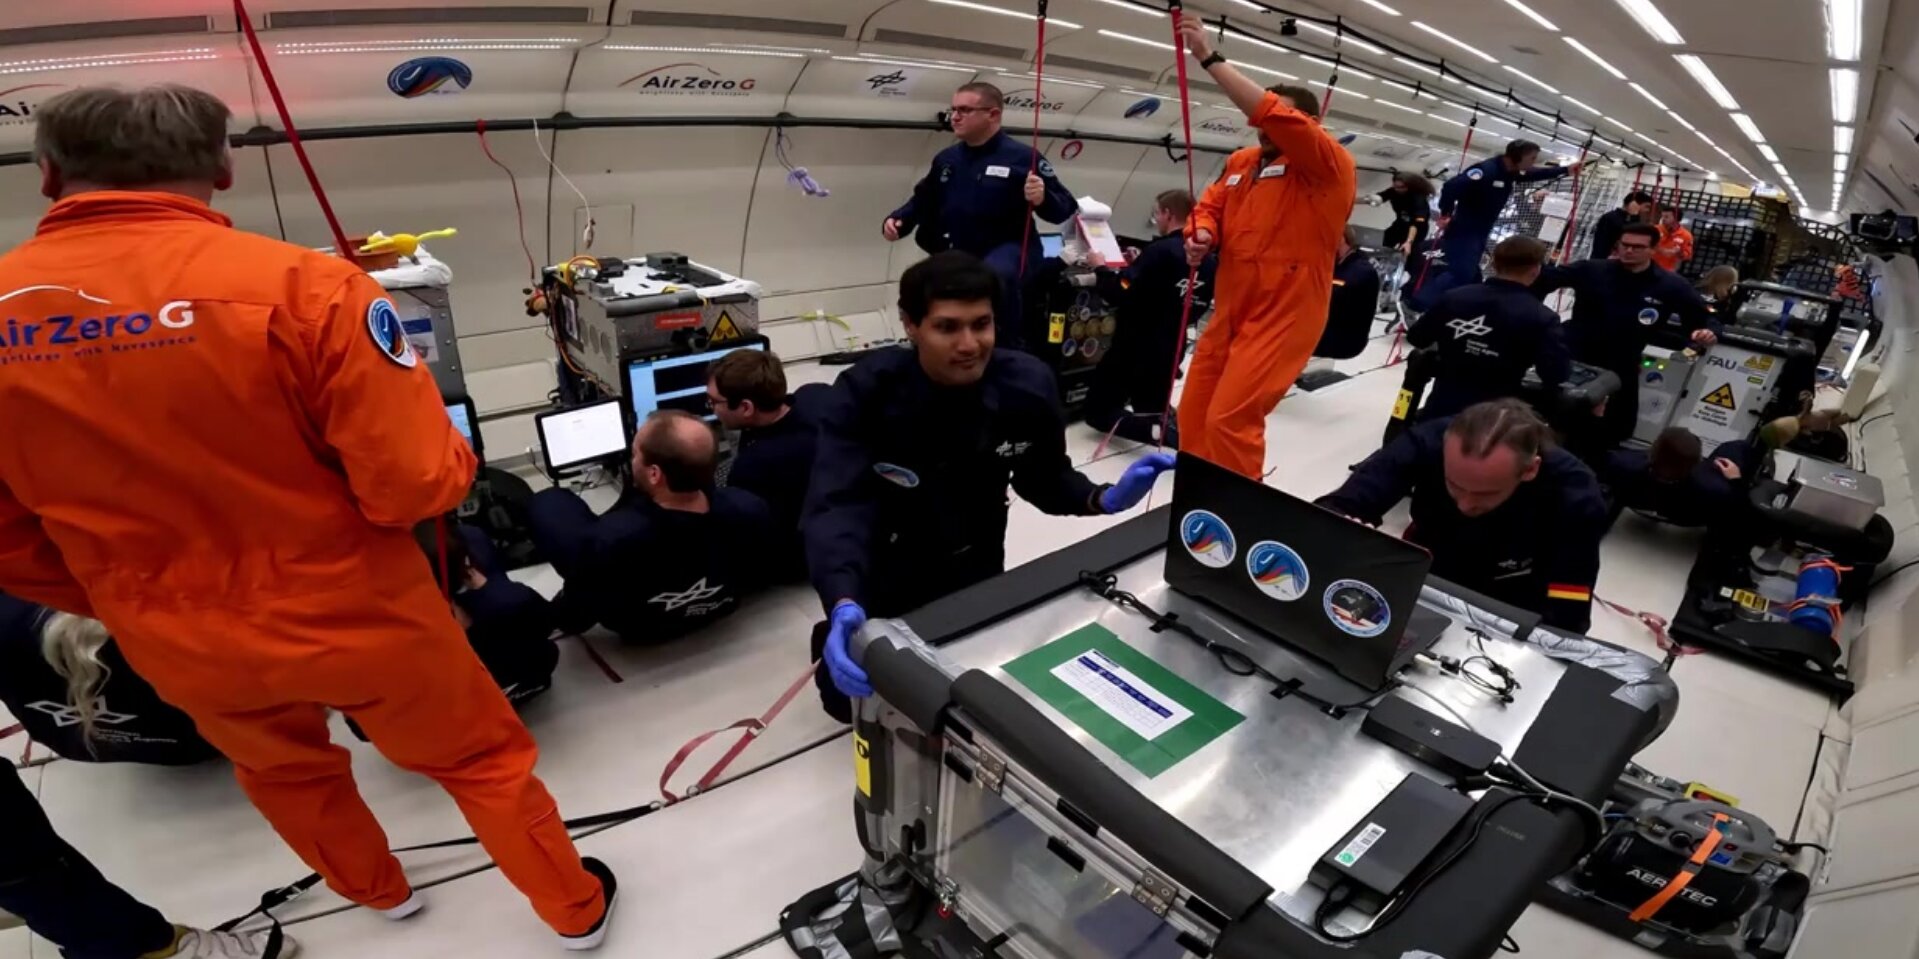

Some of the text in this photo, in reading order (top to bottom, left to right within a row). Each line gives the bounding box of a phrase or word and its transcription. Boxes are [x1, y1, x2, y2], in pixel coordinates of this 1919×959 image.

[740, 78, 756, 91] G
[158, 300, 195, 329] G
[1706, 355, 1737, 370] FAU
[1626, 868, 1718, 906] AERTEC
